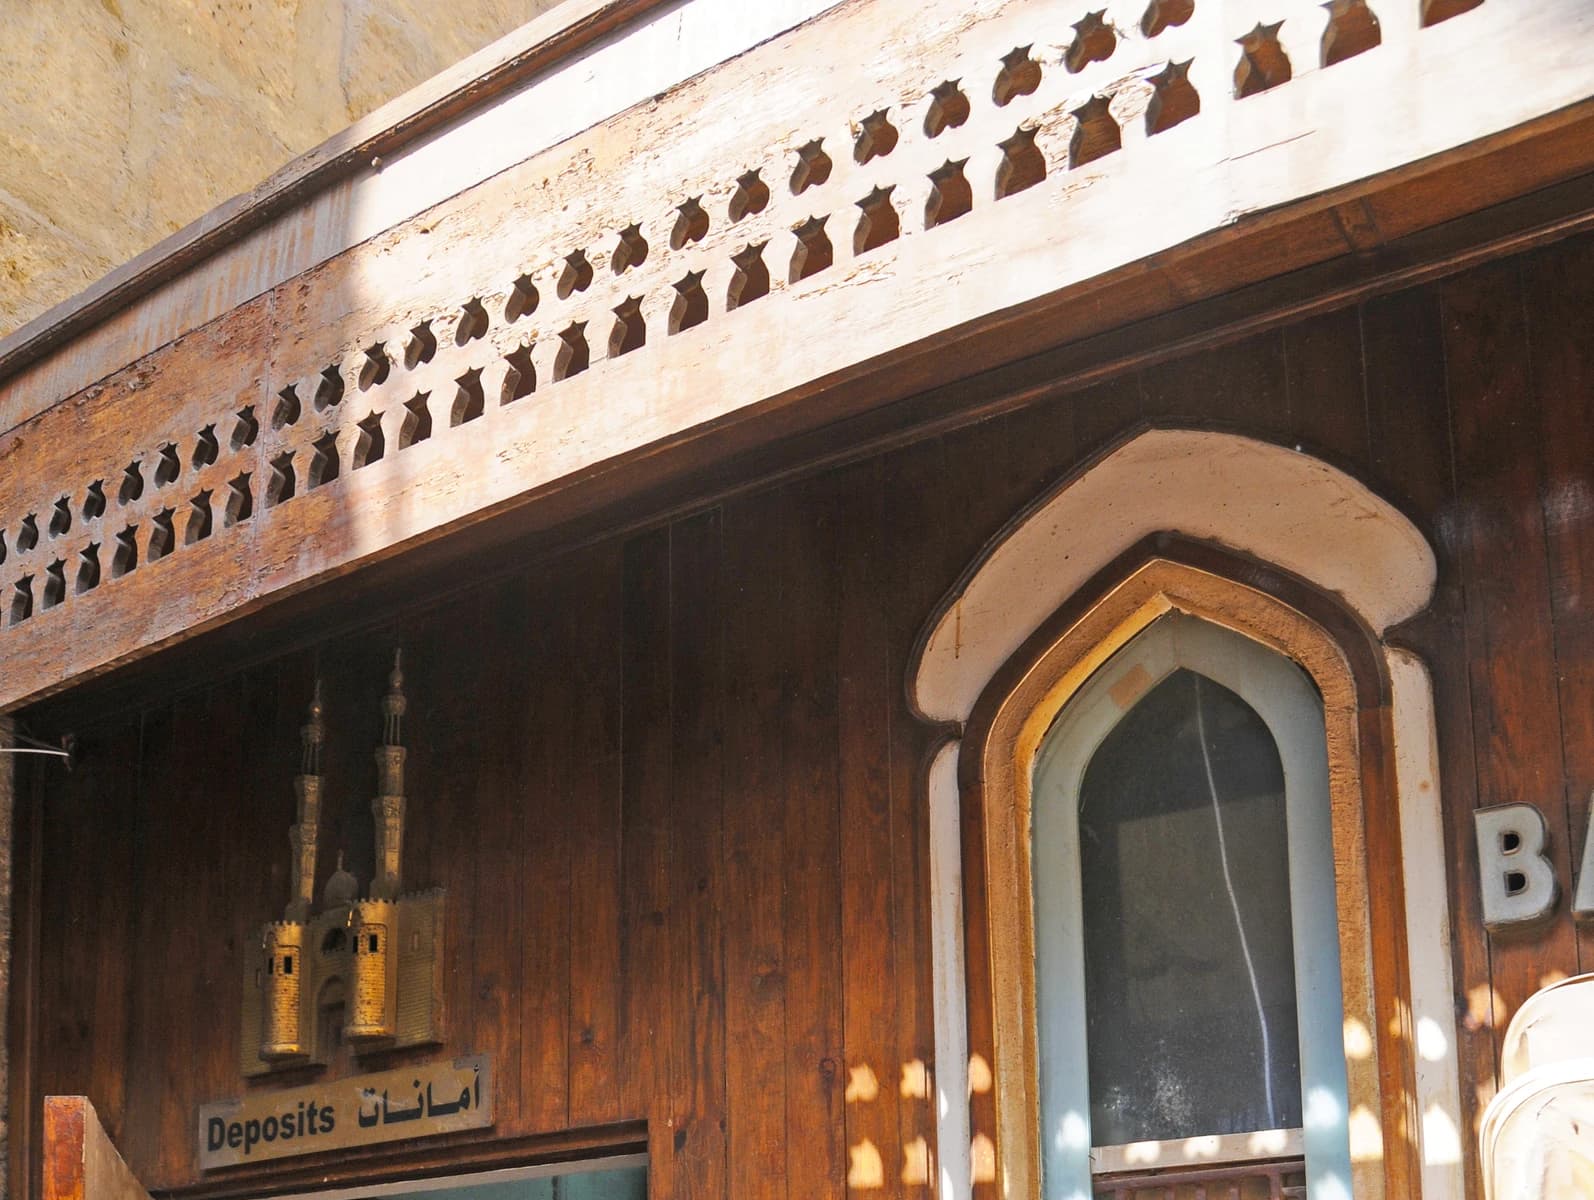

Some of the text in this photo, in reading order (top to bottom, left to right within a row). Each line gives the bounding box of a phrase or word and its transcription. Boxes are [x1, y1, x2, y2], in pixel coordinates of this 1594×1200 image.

[1473, 788, 1594, 925] B
[207, 1101, 335, 1154] Deposits
[358, 1064, 481, 1128] أمانات
